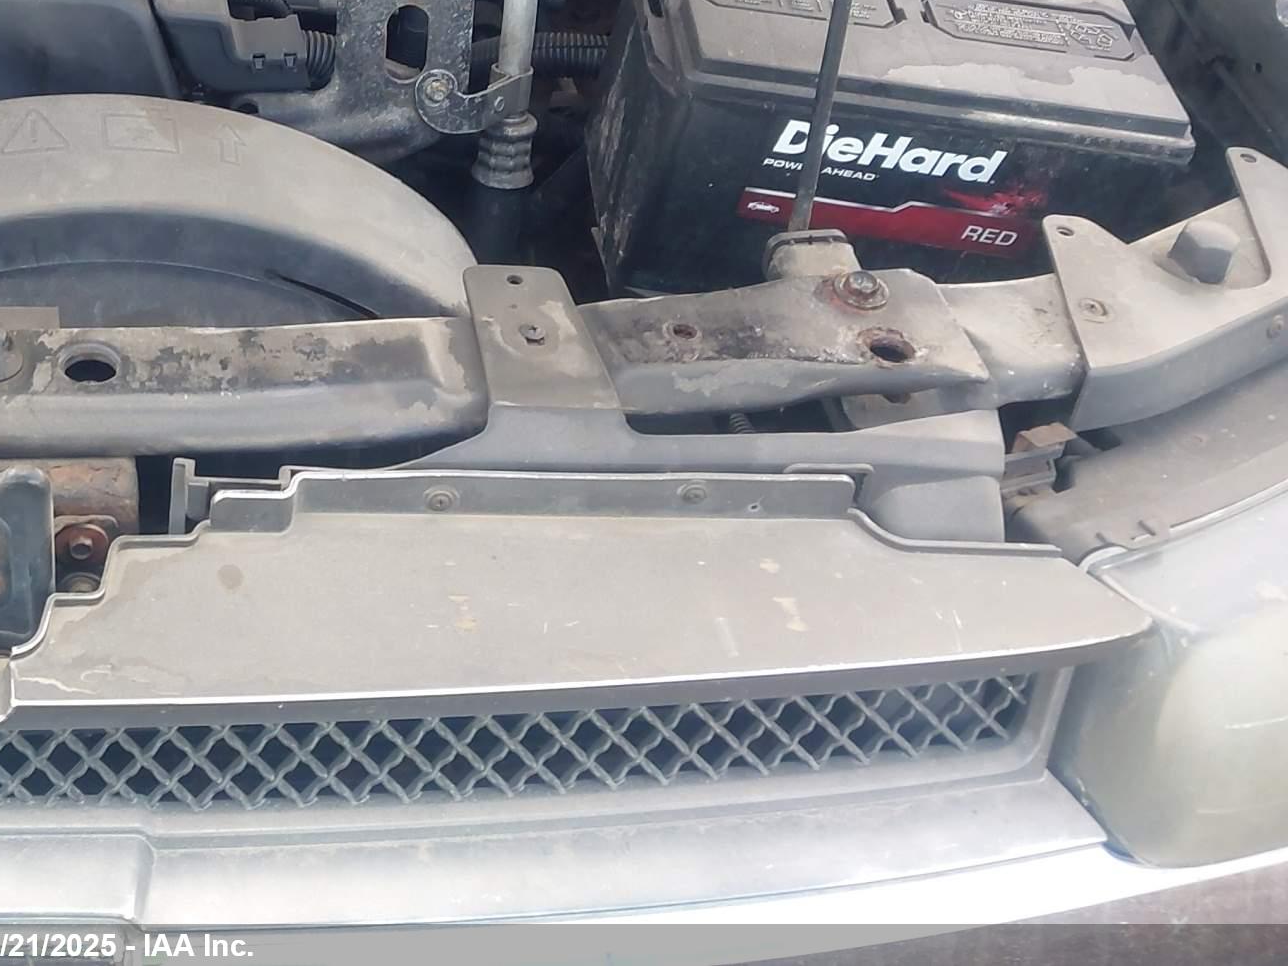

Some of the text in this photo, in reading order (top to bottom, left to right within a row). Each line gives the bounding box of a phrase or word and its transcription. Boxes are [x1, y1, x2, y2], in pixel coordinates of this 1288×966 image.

[772, 118, 1008, 184] DieHard
[762, 157, 877, 182] POW AHEAD
[961, 225, 1018, 247] RED
